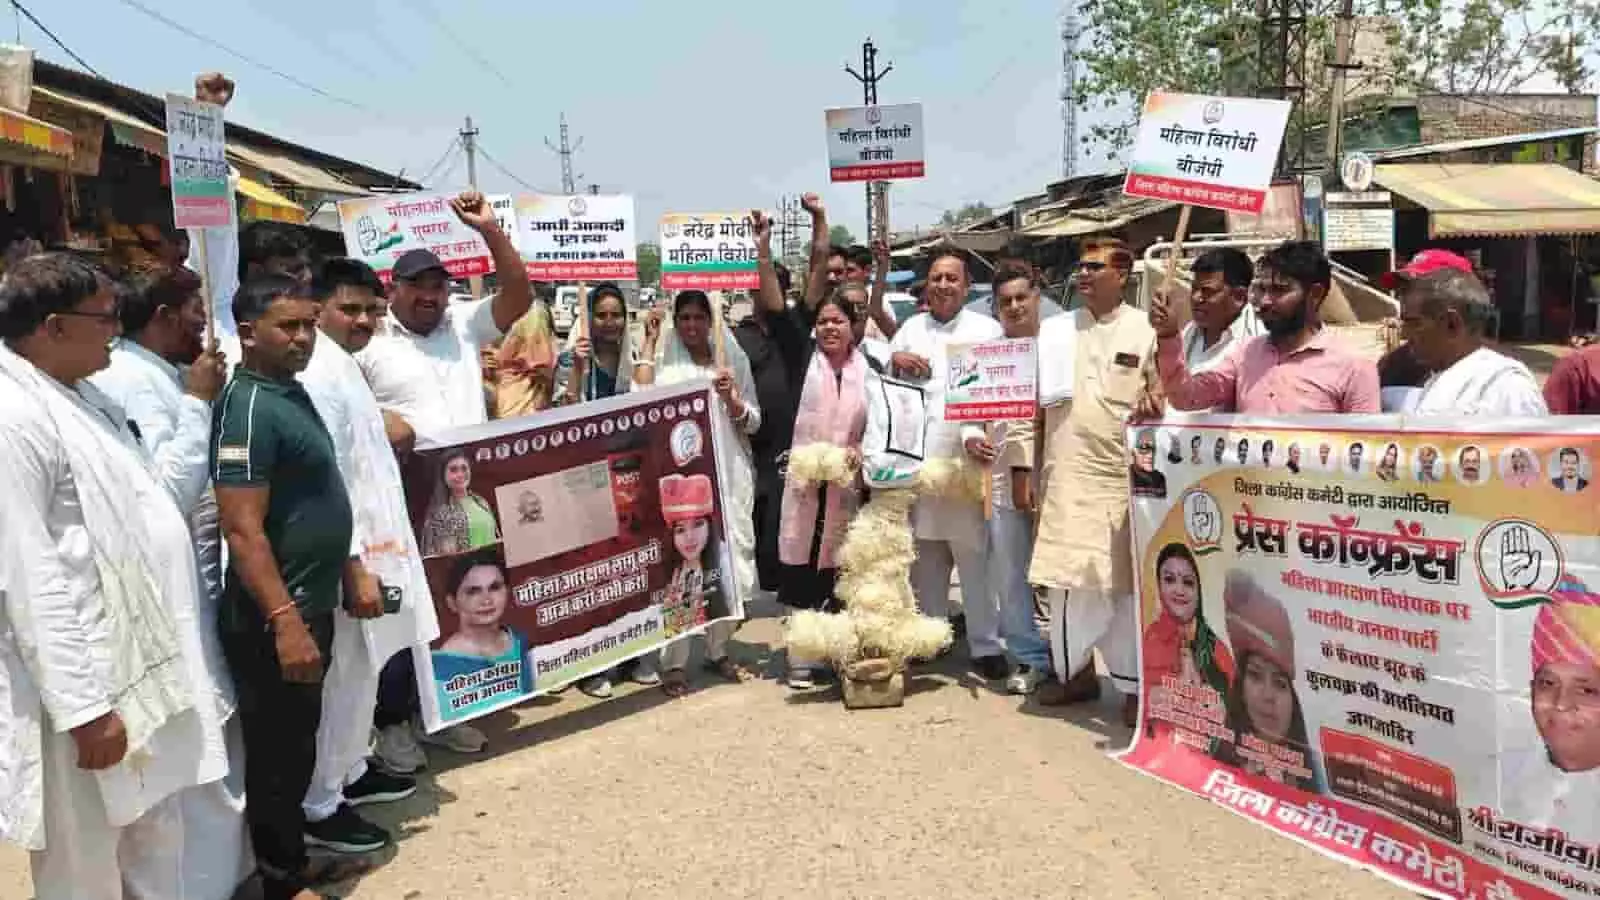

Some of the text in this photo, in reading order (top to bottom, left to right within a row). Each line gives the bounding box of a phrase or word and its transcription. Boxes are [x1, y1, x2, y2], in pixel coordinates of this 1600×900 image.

[839, 127, 873, 144] महिला
[1160, 123, 1258, 152] महिला विरोधी
[530, 218, 569, 231] आधी
[682, 216, 751, 240] नरेंद्र मोदी
[668, 242, 760, 264] महिला विरोध
[1234, 476, 1262, 497] जिला
[1307, 485, 1343, 505] कमेटी
[1348, 492, 1375, 509] द्वारा
[1379, 492, 1450, 515] आयोजित
[1232, 502, 1465, 582] प्रेस कॉन्फ्रेंस
[516, 538, 660, 602] महिला आरक्षण लागू करो
[540, 604, 569, 625] आज
[596, 582, 622, 602] अभी
[1280, 570, 1322, 595] महिला
[1445, 602, 1471, 621] पर
[1356, 619, 1398, 642] जनता
[537, 655, 561, 676] जिला
[564, 646, 590, 667] महिला
[445, 672, 481, 694] महिला
[1360, 679, 1379, 701] की
[1381, 688, 1455, 726] असलियत
[1346, 711, 1416, 745] जगजाहिर
[1202, 769, 1276, 817] जिला
[1371, 831, 1465, 893] कमेटी
